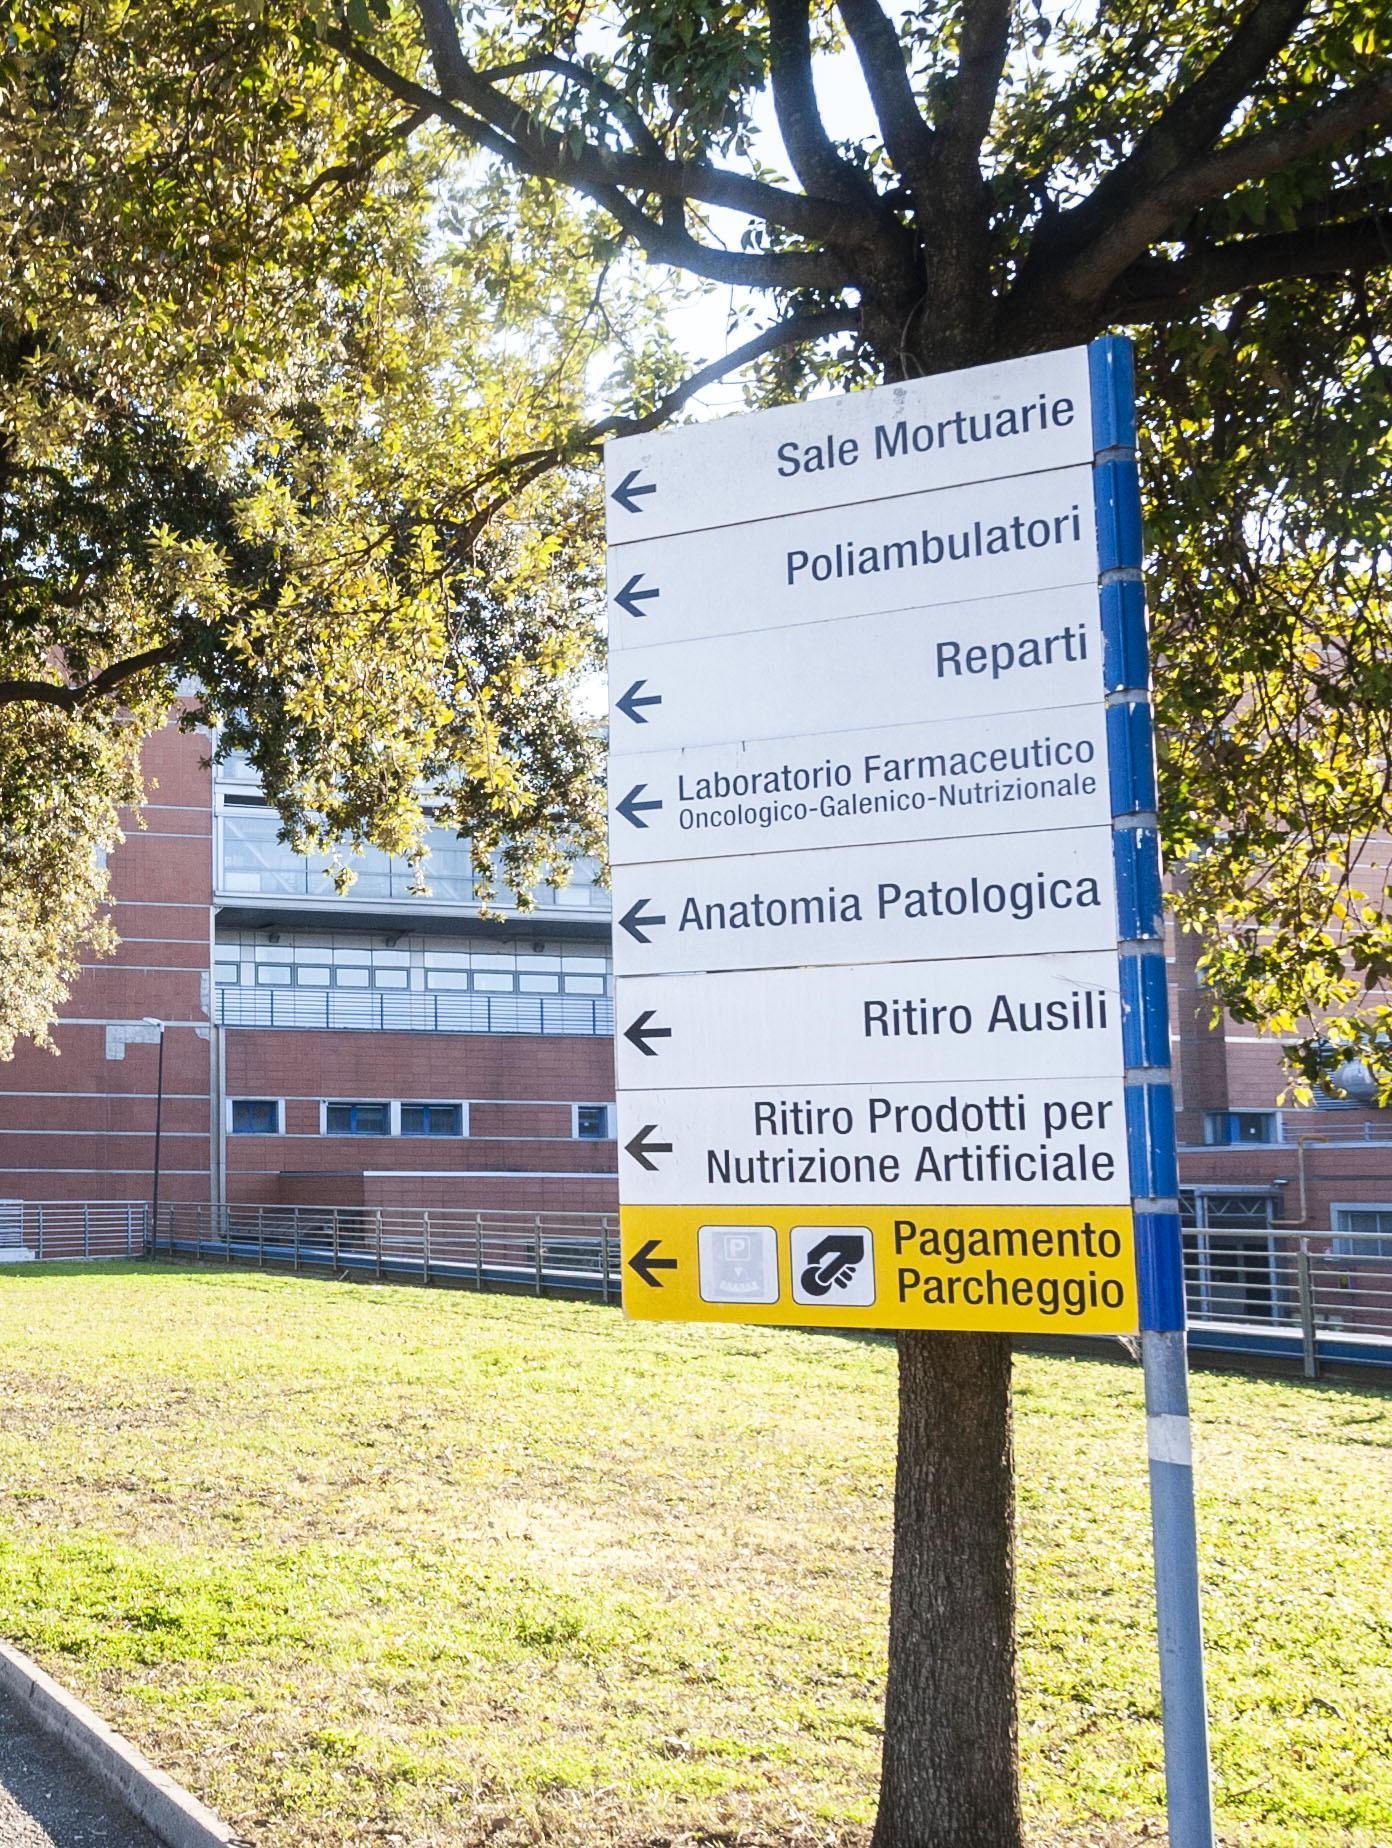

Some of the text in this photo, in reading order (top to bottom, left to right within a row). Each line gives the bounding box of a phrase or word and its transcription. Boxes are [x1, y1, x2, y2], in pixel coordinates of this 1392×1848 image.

[777, 393, 1074, 477] Sale Mortuarie
[787, 505, 1081, 585] Poliambulatori
[936, 623, 1088, 680] Reparti
[678, 737, 1095, 801] Laboratorio Farmaceutico
[679, 773, 1097, 830] Oncologico-Galenico-Nutrizionale
[678, 871, 1102, 932] Anatomia Patologica
[864, 990, 1108, 1037] Ritiro Ausili
[754, 1093, 1113, 1138] Ritiro Prodotti per
[707, 1143, 1115, 1184] Nutrizione Artificiale
[729, 1239, 746, 1257] P
[893, 1220, 1123, 1265] Pagamento
[897, 1268, 1125, 1316] Parcheggio
